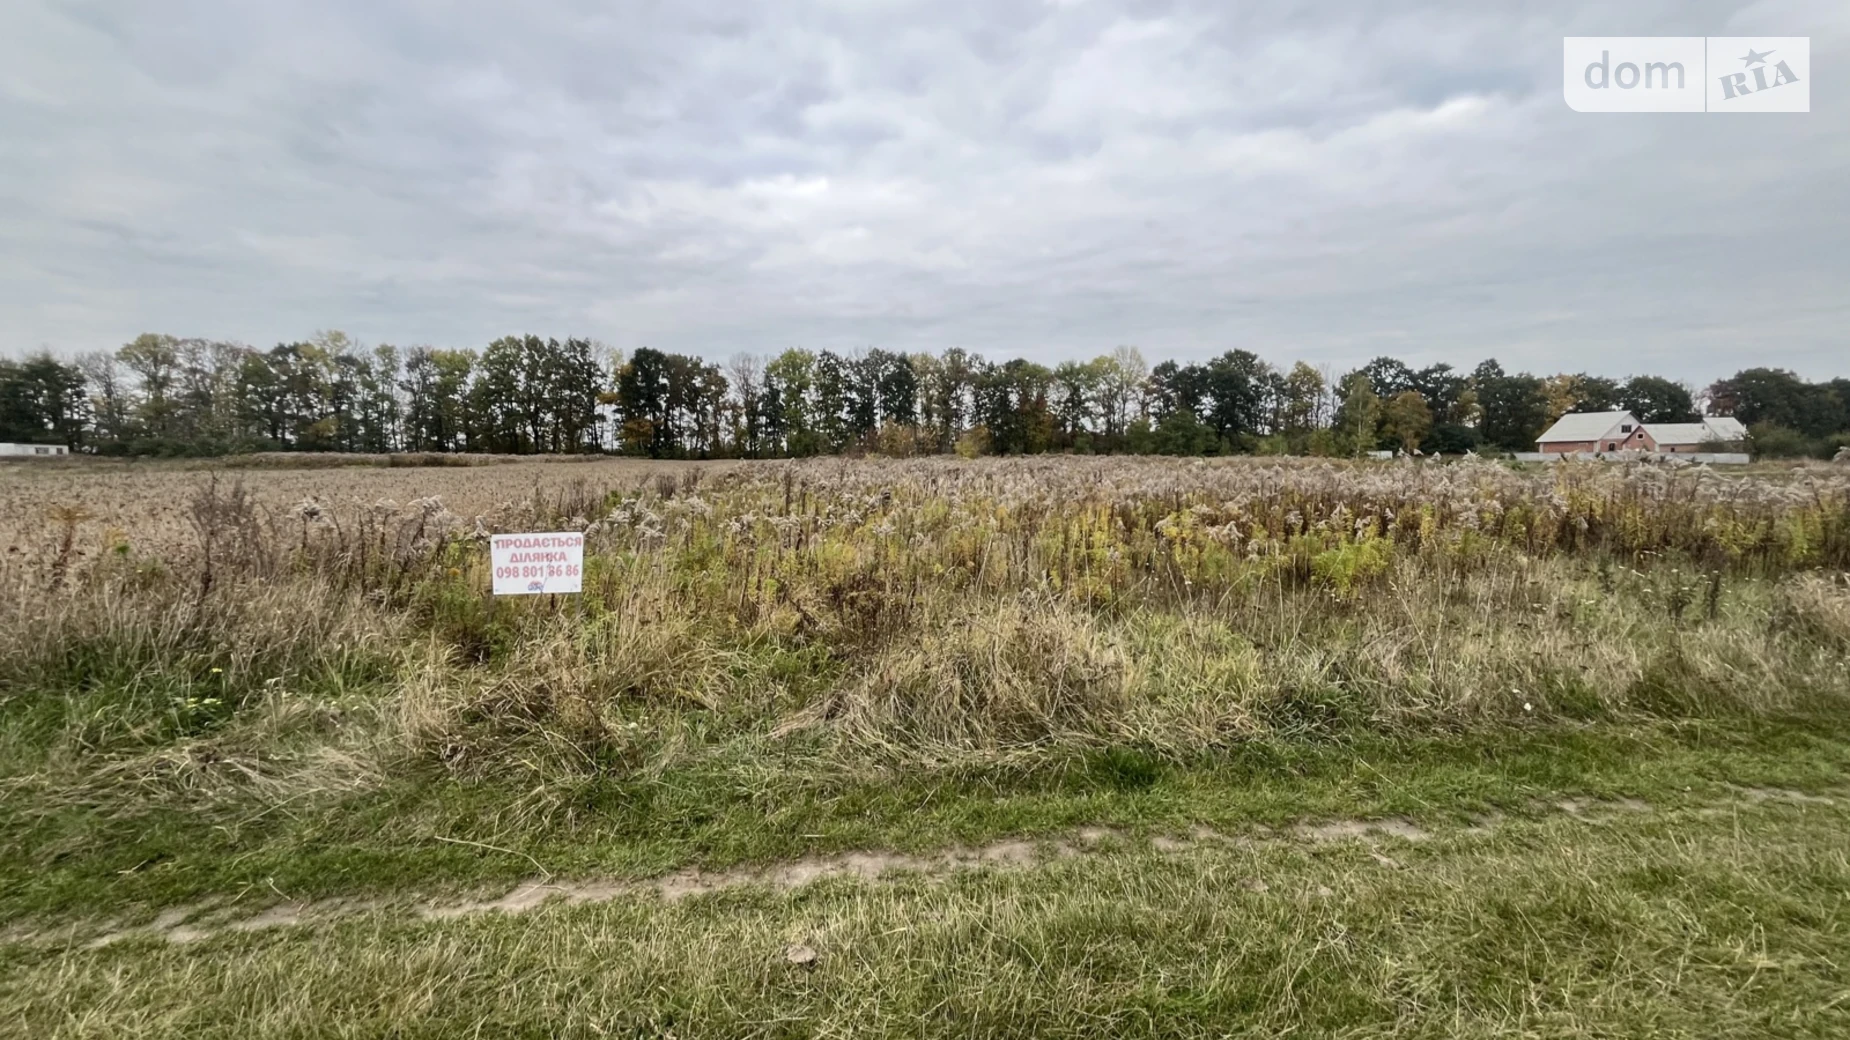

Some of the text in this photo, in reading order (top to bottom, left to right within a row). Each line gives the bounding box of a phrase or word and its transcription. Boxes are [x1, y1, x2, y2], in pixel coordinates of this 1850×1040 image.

[496, 537, 582, 549] ПРОДАЄТЬСЯ
[510, 552, 567, 562] ДІЛЯНКА
[496, 567, 519, 578] 098
[522, 566, 543, 577] 801
[565, 564, 579, 576] 86
